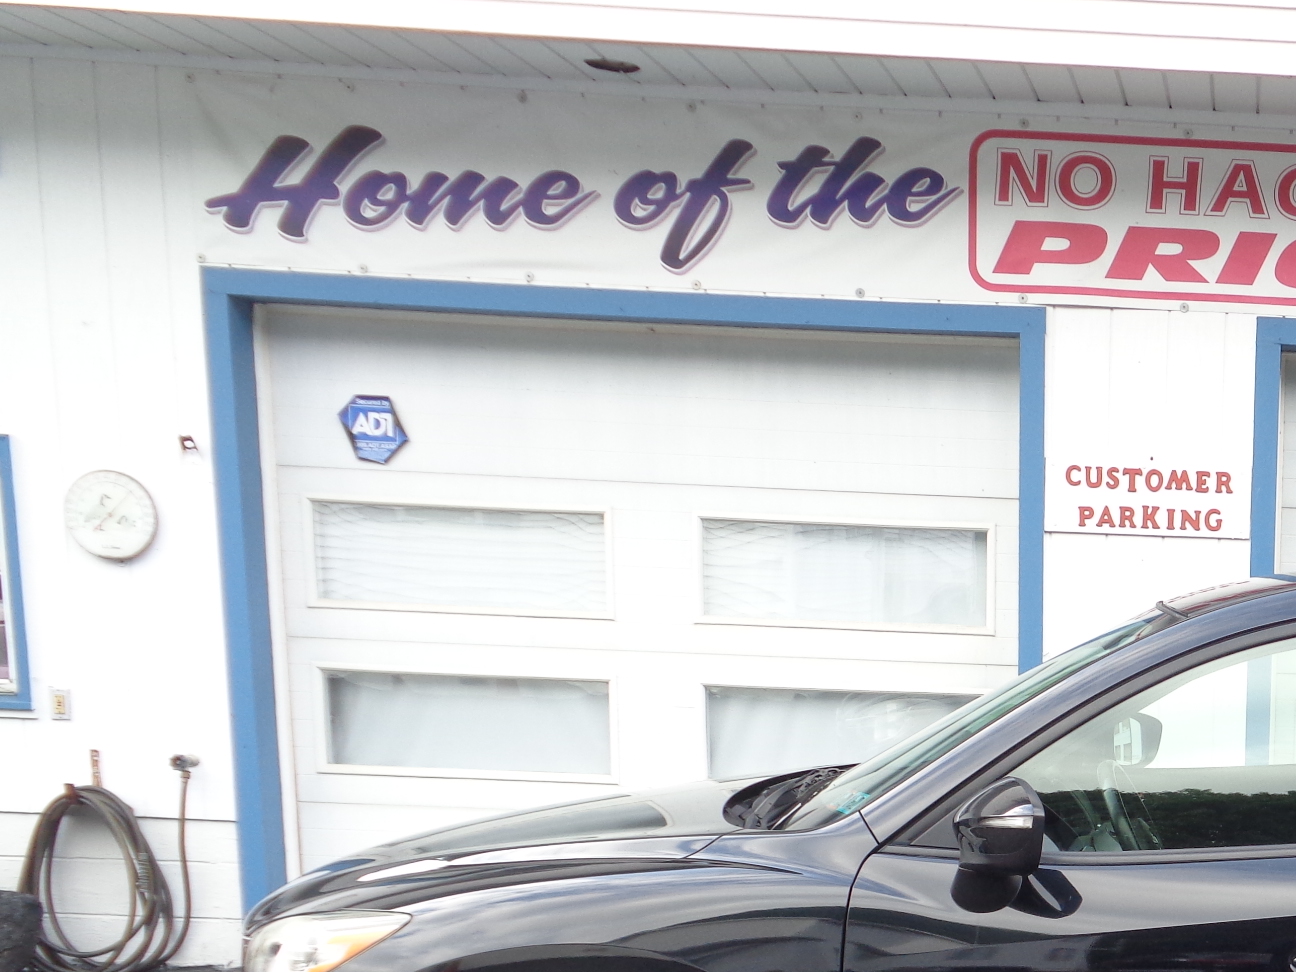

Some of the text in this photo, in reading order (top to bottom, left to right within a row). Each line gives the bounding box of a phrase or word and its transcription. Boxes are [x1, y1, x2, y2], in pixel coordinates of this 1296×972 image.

[994, 147, 1118, 211] NO
[204, 124, 964, 275] Home of the
[351, 411, 394, 438] ADT
[1065, 464, 1234, 495] CUSTOMER
[1077, 504, 1223, 532] PARKING
